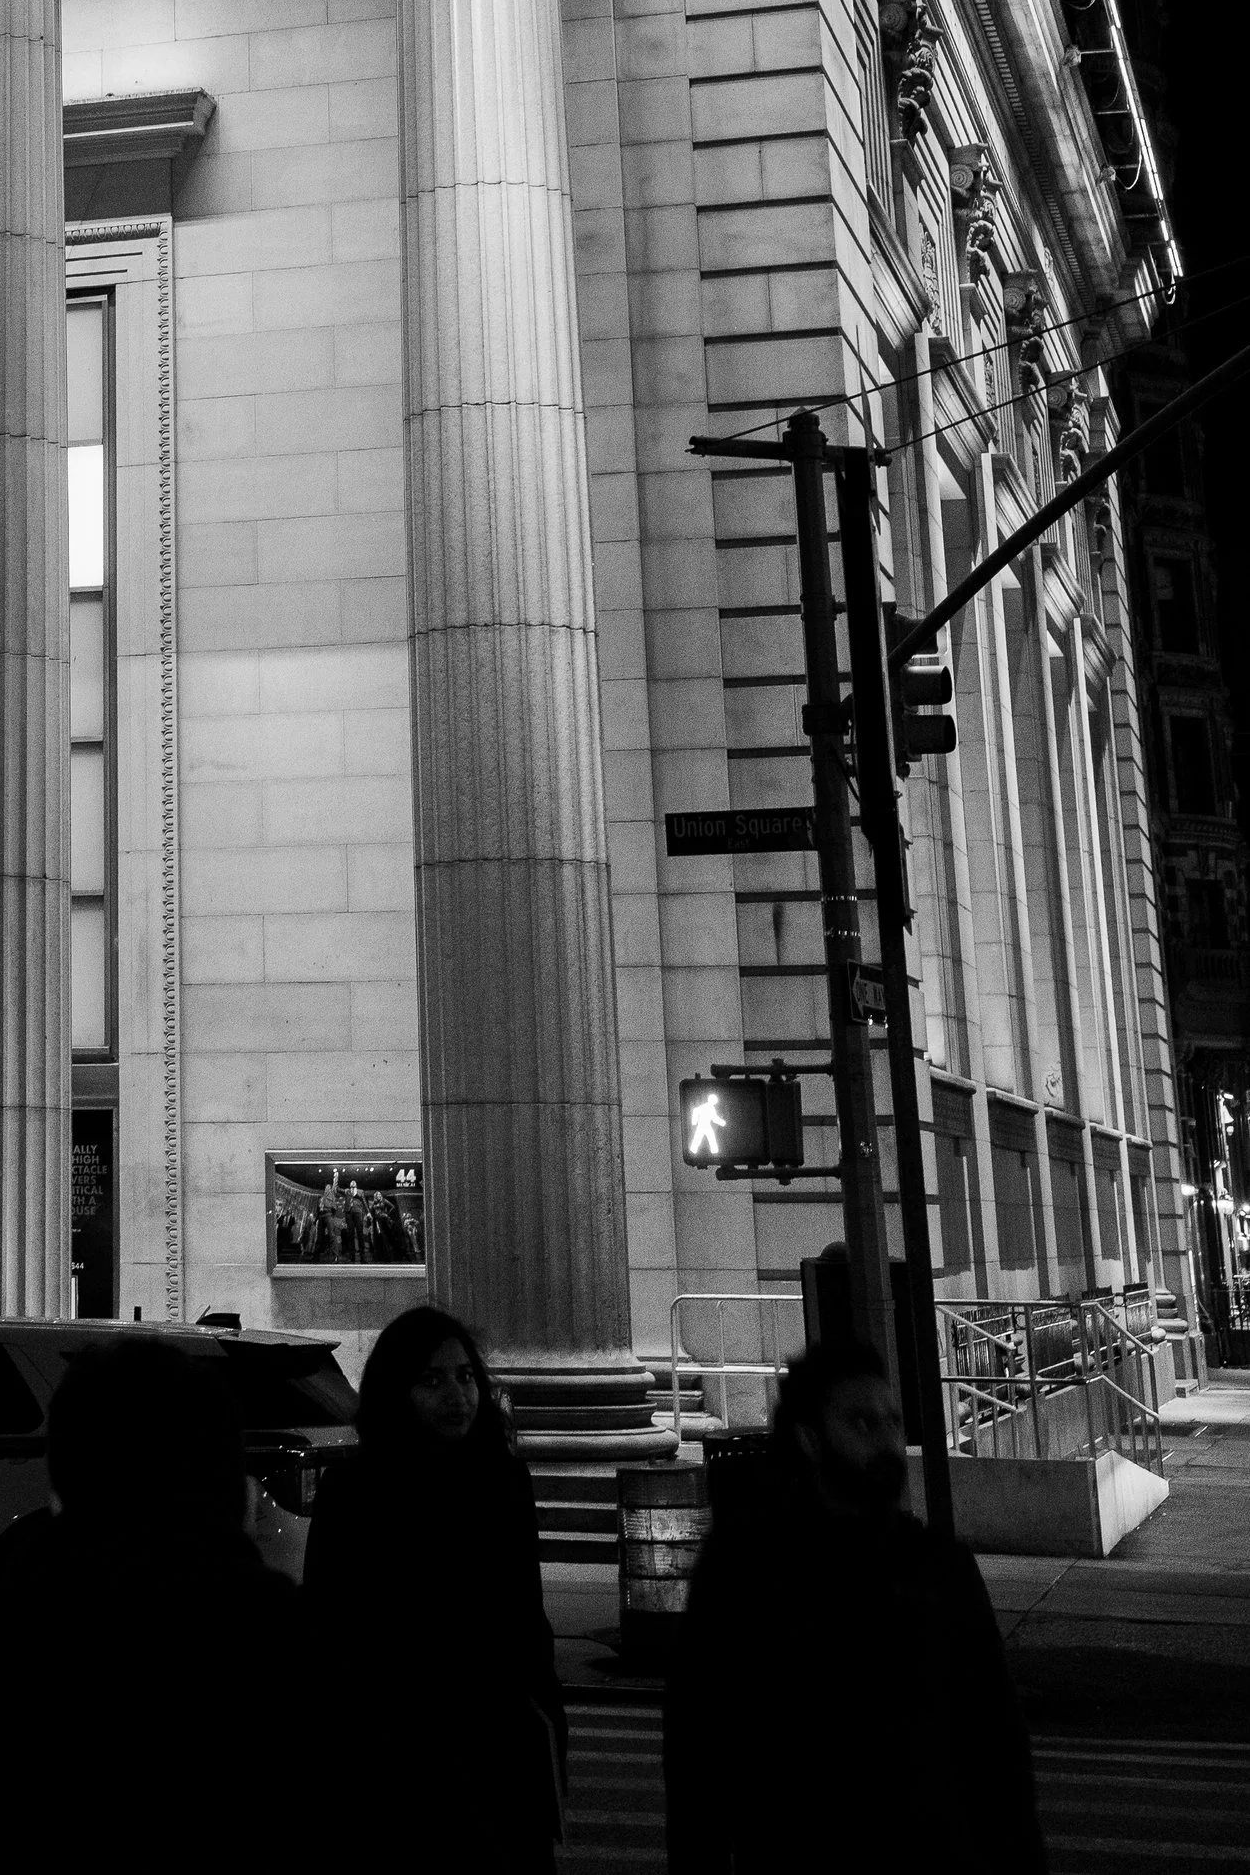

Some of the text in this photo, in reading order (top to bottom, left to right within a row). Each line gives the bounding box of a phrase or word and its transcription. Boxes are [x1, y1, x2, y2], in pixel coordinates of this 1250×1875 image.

[673, 814, 803, 840] Union Square
[727, 837, 751, 850] East
[73, 1145, 98, 1154] ALLY
[72, 1165, 108, 1174] CTACLE
[72, 1175, 97, 1184] VERS
[395, 1168, 417, 1182] 44
[72, 1185, 104, 1195] ITICAL
